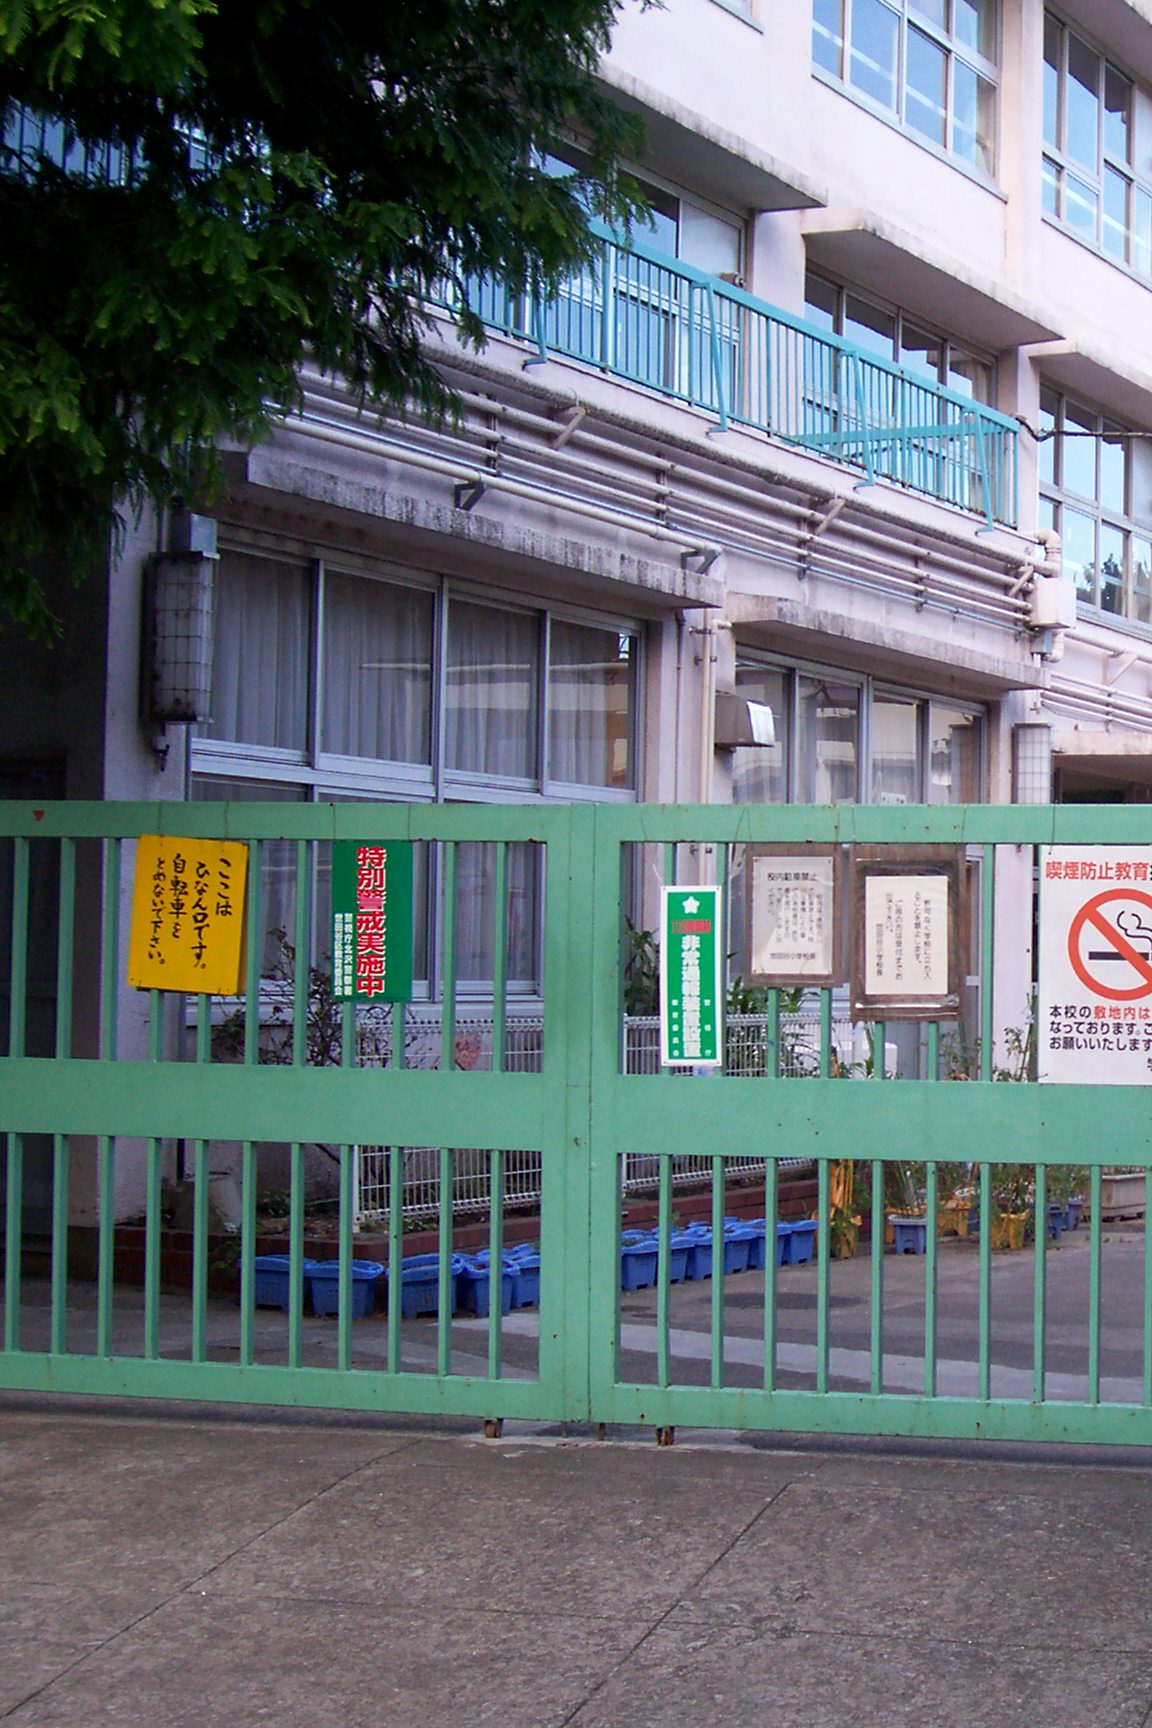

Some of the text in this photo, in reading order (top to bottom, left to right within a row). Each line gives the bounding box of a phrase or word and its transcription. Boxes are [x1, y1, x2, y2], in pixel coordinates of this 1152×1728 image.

[168, 853, 189, 939] 自転車を
[215, 857, 232, 917] ここは
[356, 845, 387, 998] 特別警戒実施中
